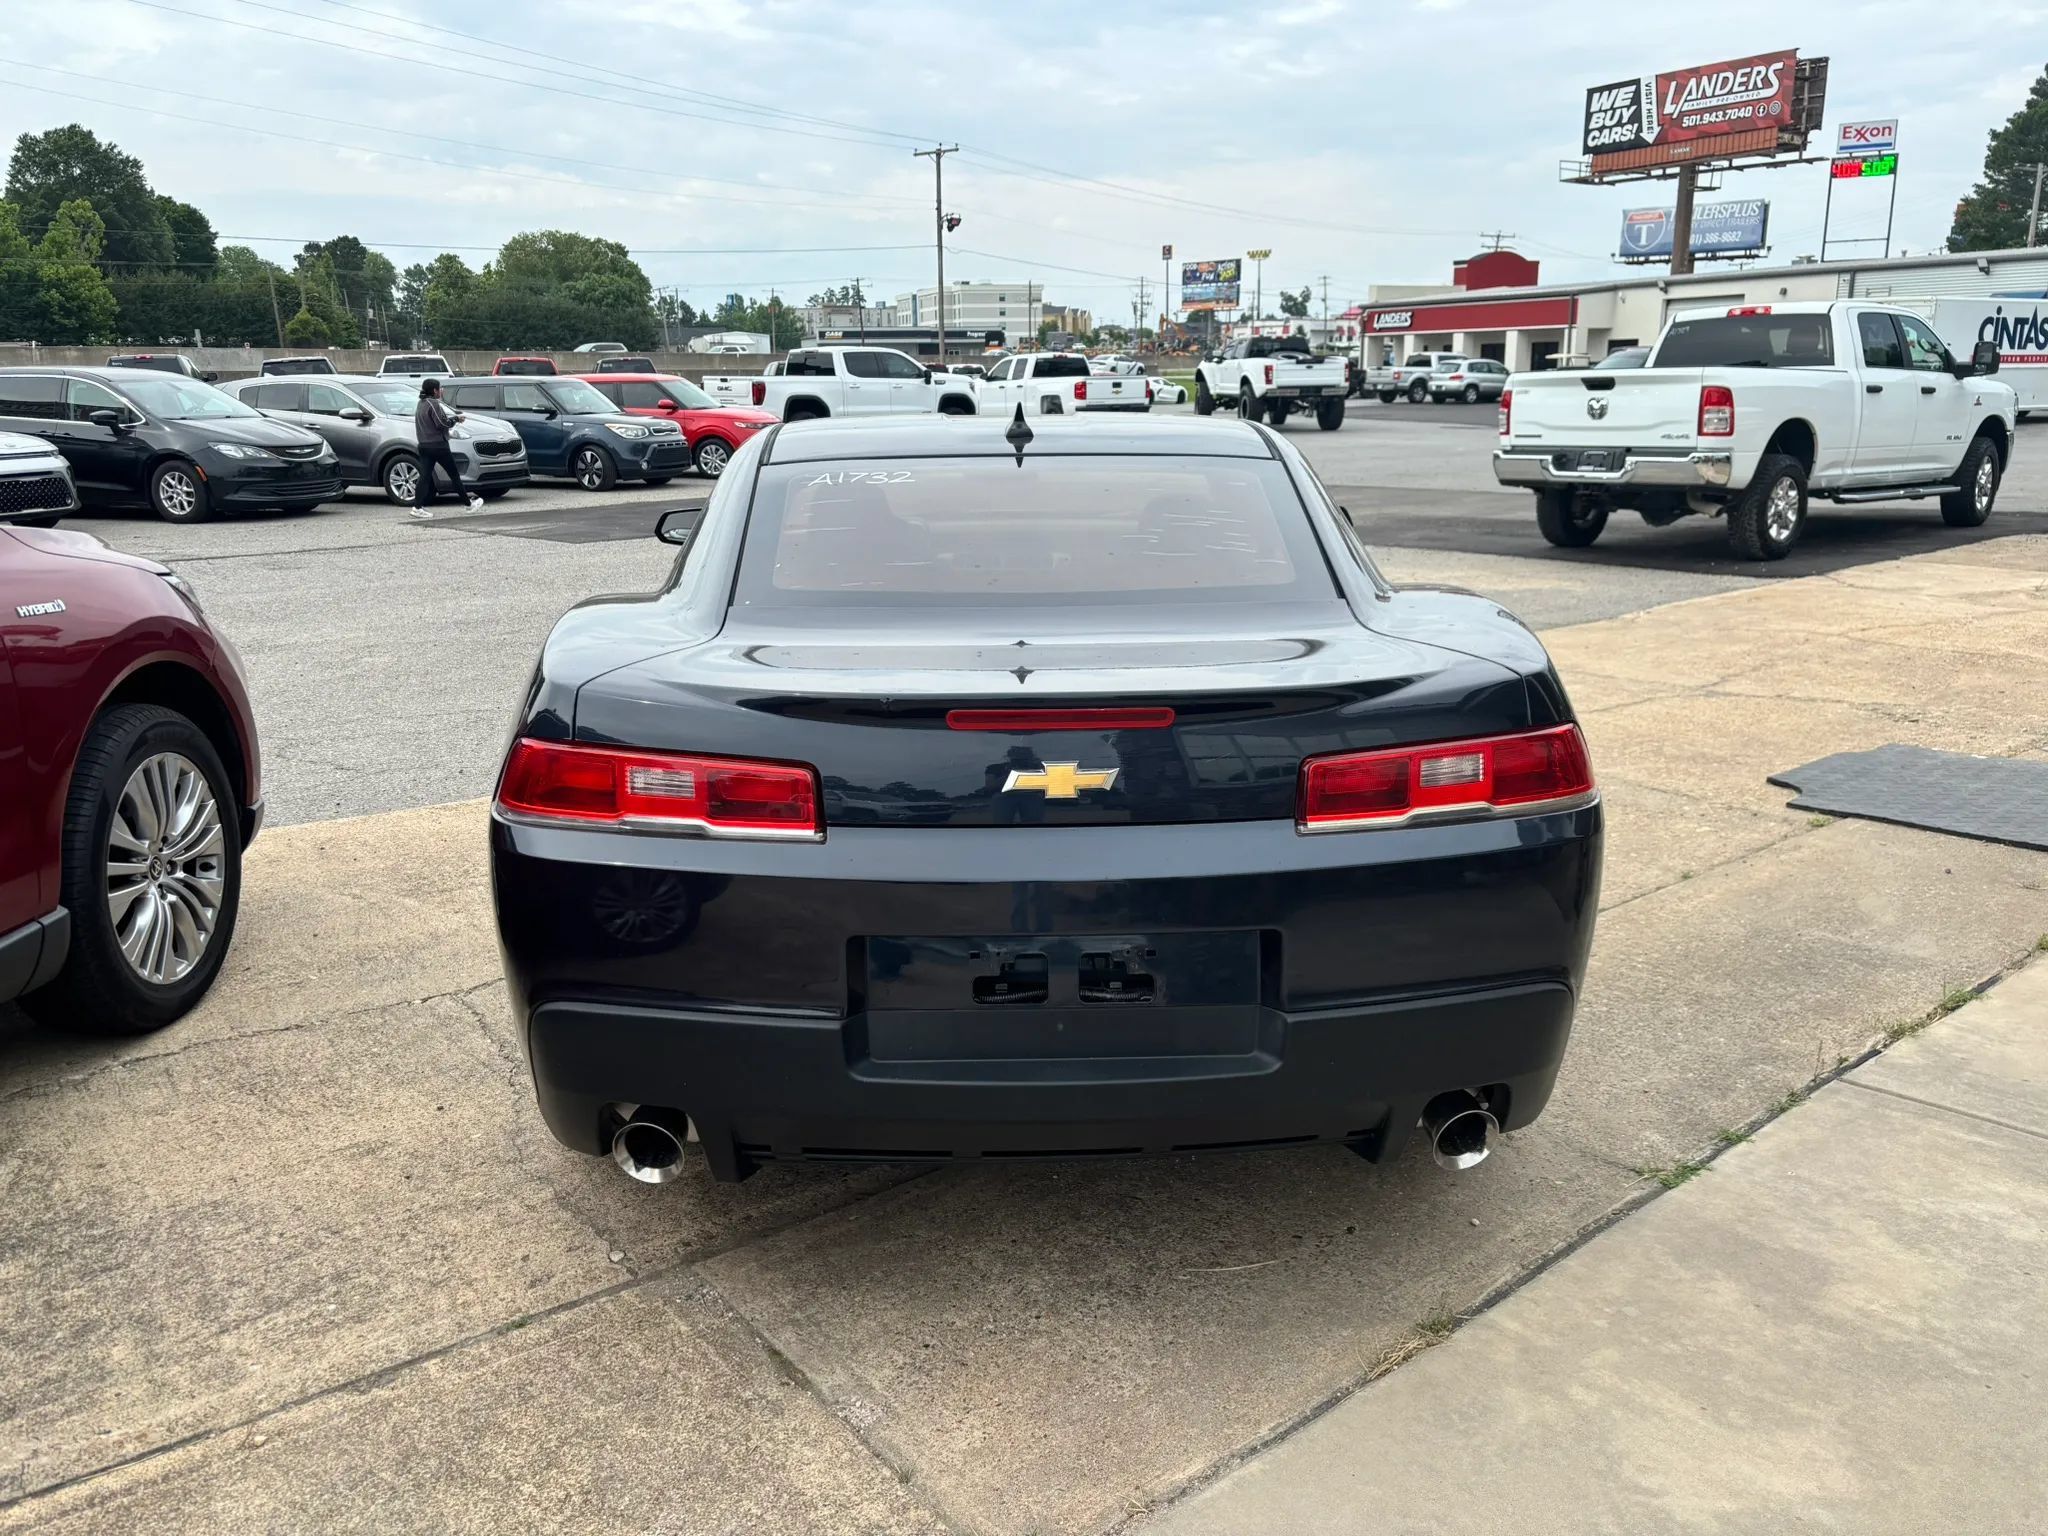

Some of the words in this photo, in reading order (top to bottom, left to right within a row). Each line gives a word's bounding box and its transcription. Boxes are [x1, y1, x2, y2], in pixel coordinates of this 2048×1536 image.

[1590, 85, 1637, 113] WE
[1644, 82, 1653, 105] VISIT
[1663, 61, 1784, 119] LANDERS
[1686, 99, 1713, 108] FAMILY
[1715, 91, 1761, 104] PRE-OWNED
[1588, 105, 1638, 130] BUY
[1681, 106, 1753, 128] 501.943.7040
[1587, 123, 1639, 148] CARS!
[1842, 125, 1892, 142] Exxon
[1373, 311, 1412, 330] LANDERS
[808, 471, 915, 487] A1732
[15, 599, 66, 617] HYBRID
